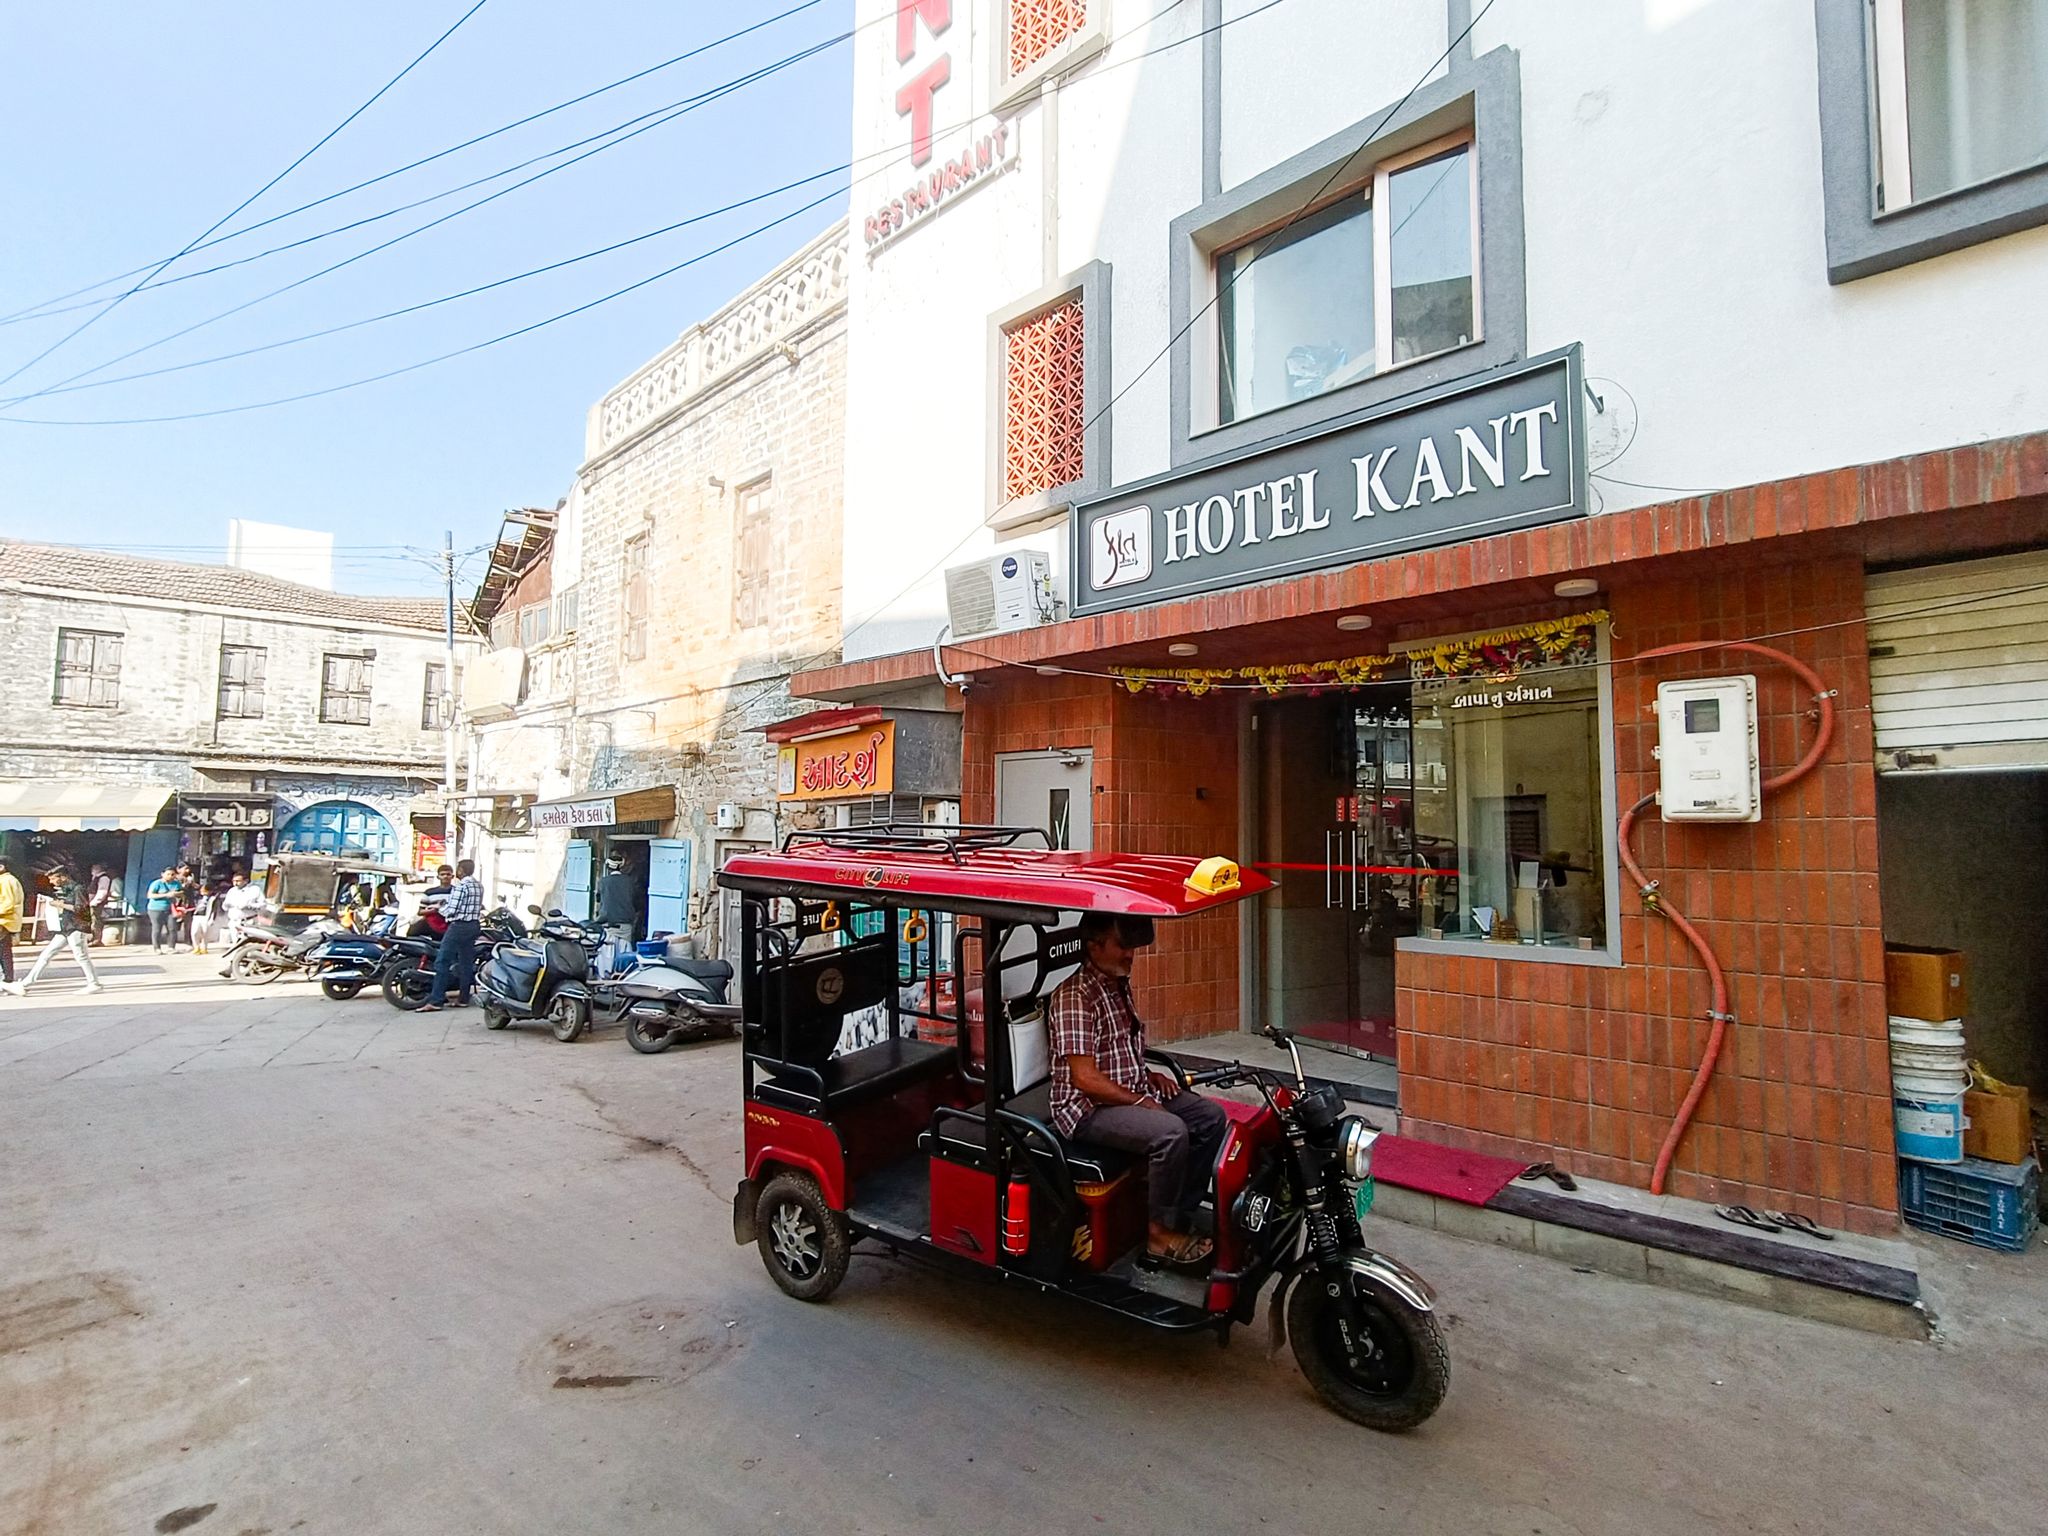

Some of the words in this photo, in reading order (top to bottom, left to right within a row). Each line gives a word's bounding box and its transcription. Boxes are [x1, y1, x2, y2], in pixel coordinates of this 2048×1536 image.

[864, 124, 1009, 246] RESTAURANT
[1162, 467, 1332, 566] HOTEL
[1350, 399, 1560, 521] KANT
[801, 731, 885, 792] આદર્શ
[542, 806, 569, 825] કમલેશ
[569, 804, 585, 824] કેશ
[587, 808, 604, 823] કલા
[835, 867, 866, 881] CITY
[882, 870, 911, 886] LIFE
